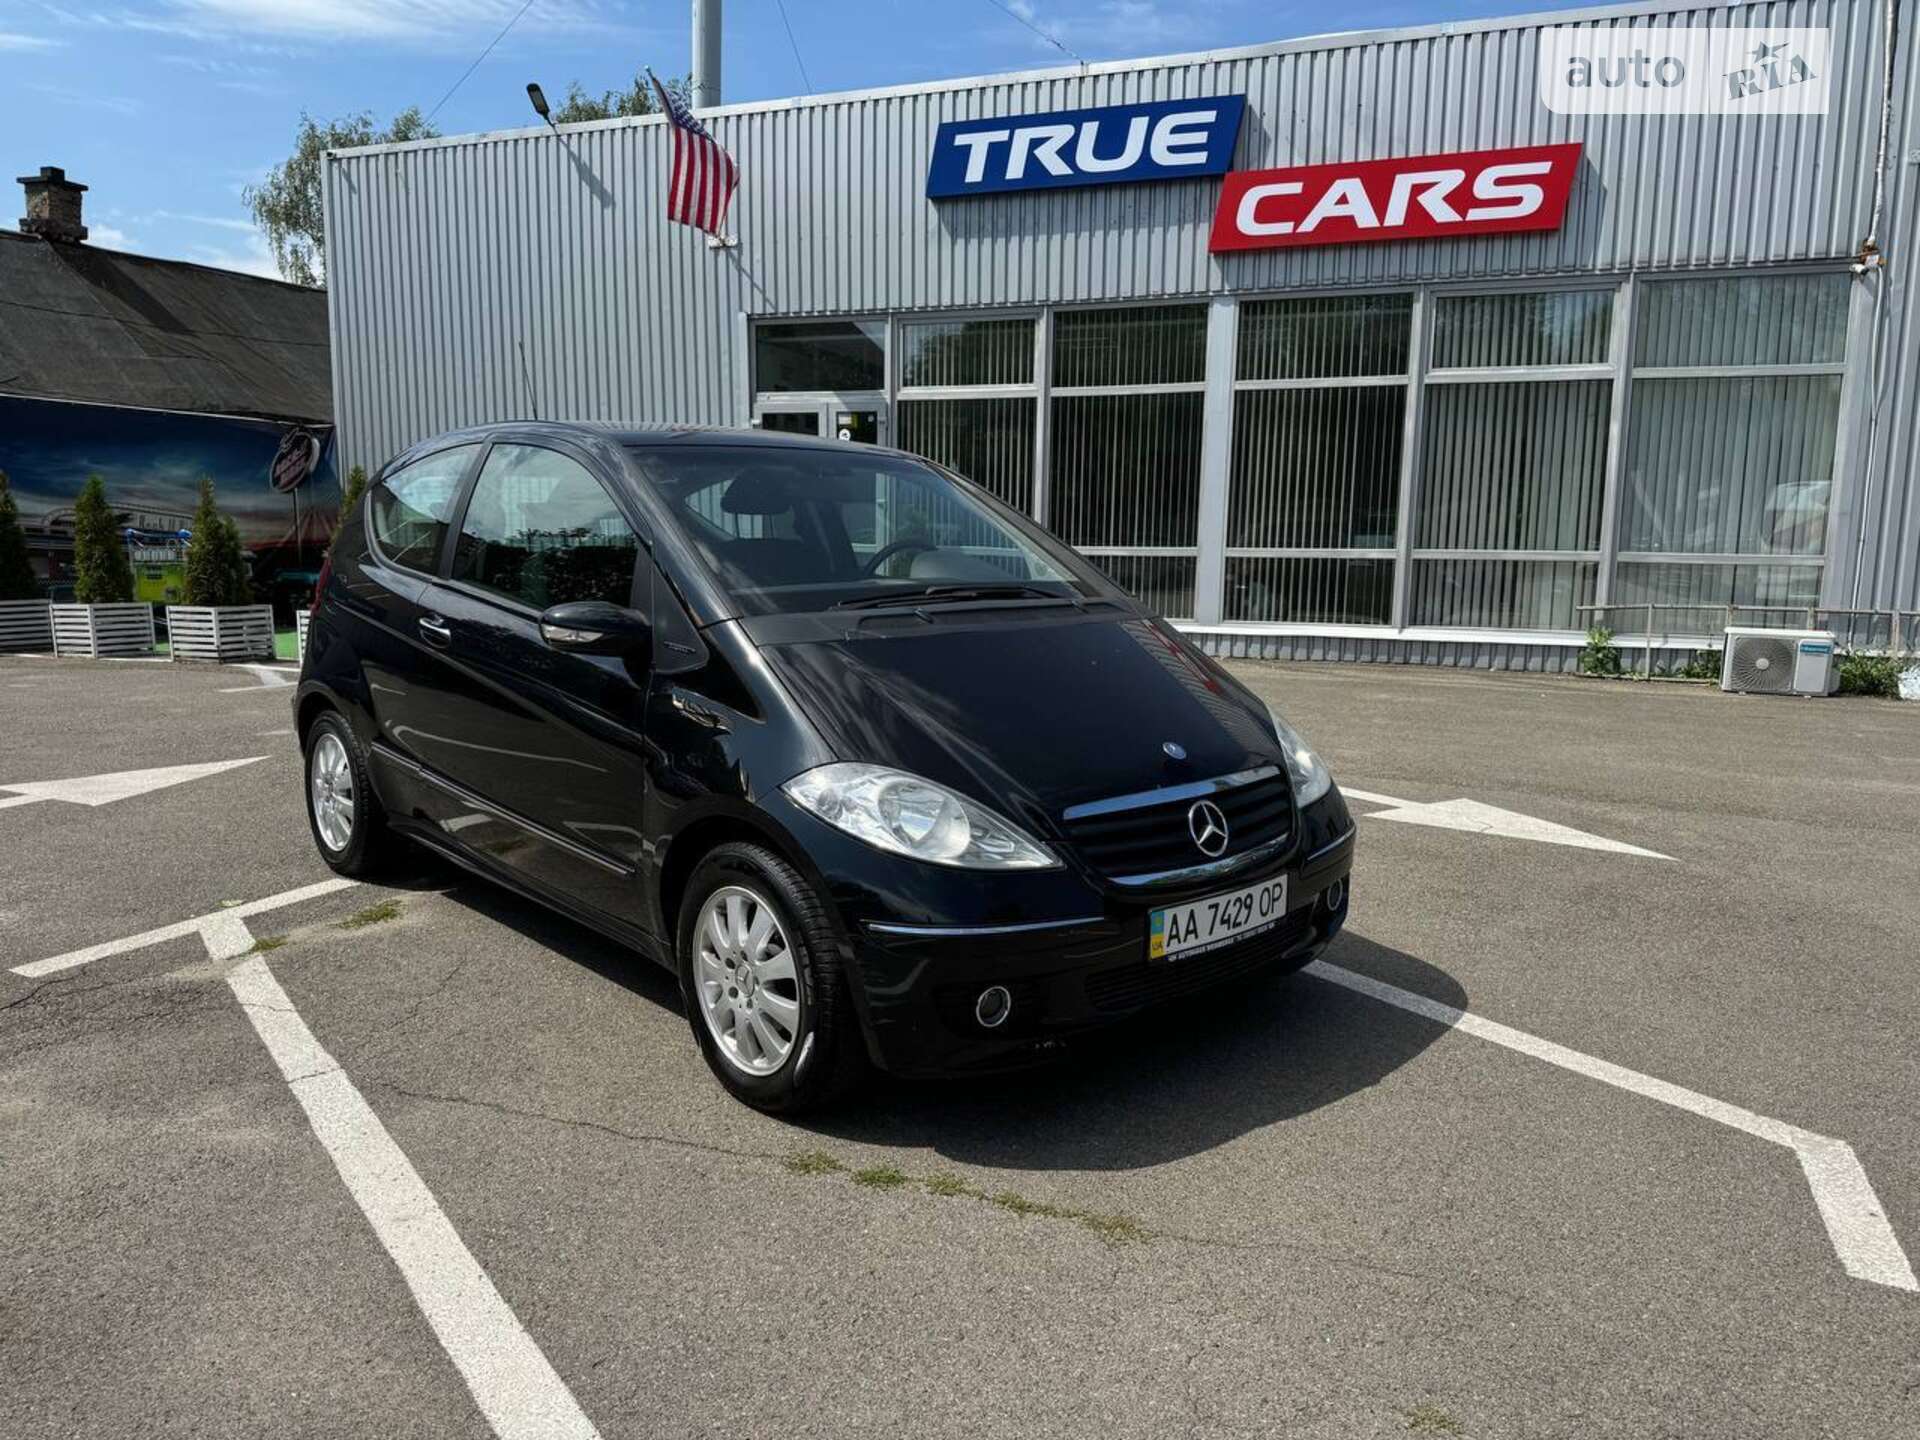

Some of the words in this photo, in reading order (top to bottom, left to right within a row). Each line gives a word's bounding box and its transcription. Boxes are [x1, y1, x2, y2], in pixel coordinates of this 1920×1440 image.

[953, 109, 1218, 183] TRUE
[1235, 160, 1553, 237] CARS
[1166, 908, 1199, 948] AA
[1207, 892, 1252, 936] 7429
[1259, 882, 1284, 917] OP
